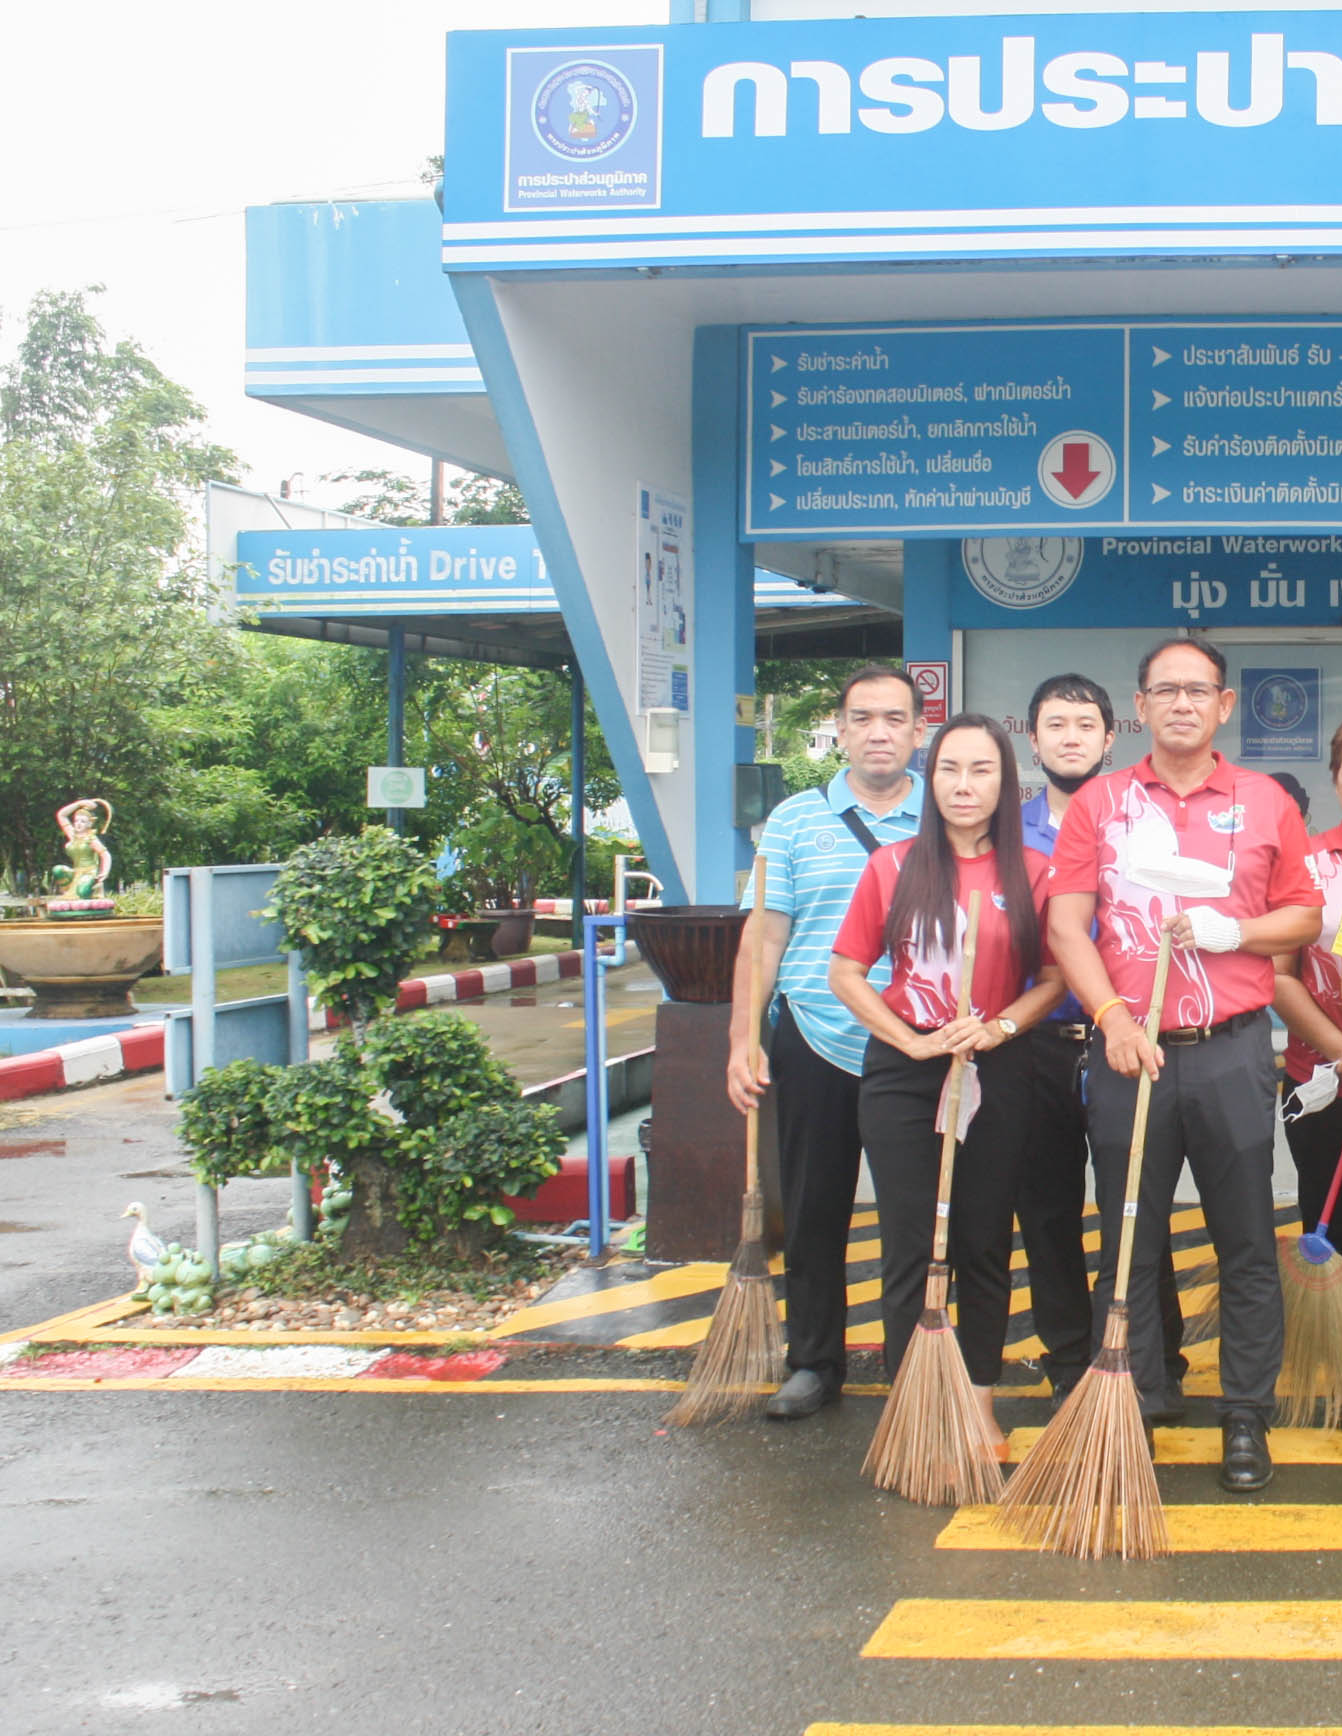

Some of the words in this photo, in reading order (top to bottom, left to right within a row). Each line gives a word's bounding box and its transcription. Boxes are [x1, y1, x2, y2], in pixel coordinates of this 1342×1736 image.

[1183, 343, 1300, 366] ประชาสัมพันธ์
[1307, 343, 1332, 366] รับ
[1102, 536, 1212, 556] Provincial
[429, 547, 517, 581] Drive
[532, 548, 548, 580] T
[1172, 571, 1228, 619] มุ่ง
[1250, 562, 1305, 608] มั่น
